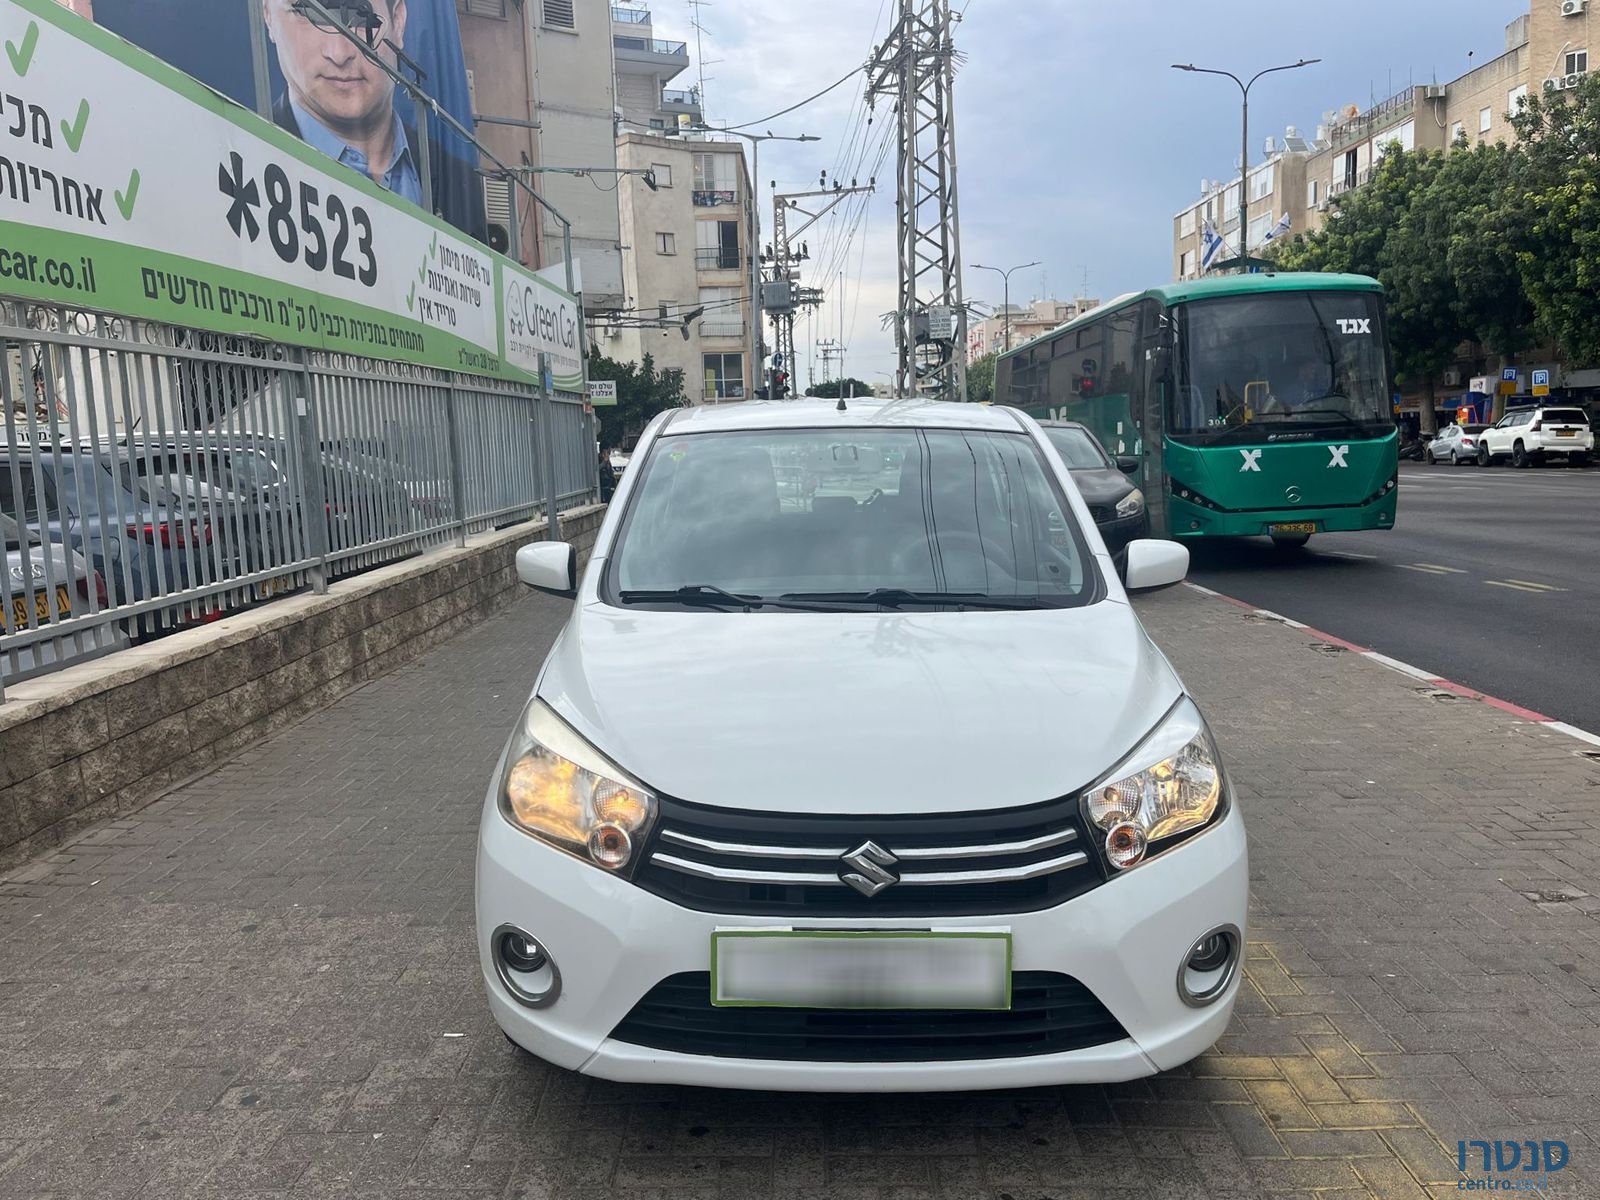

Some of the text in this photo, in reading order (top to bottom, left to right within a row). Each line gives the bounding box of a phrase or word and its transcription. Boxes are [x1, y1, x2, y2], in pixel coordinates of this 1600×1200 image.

[439, 244, 460, 272] מימון
[141, 267, 214, 311] חדשים
[427, 269, 480, 308] שירות ואמינות
[218, 285, 275, 324] ורכבים
[418, 296, 456, 327] טרייד אין
[523, 286, 576, 350] Green Car
[320, 312, 348, 338] רכבי
[349, 318, 388, 346] במכירת
[388, 327, 425, 352] מתמחים
